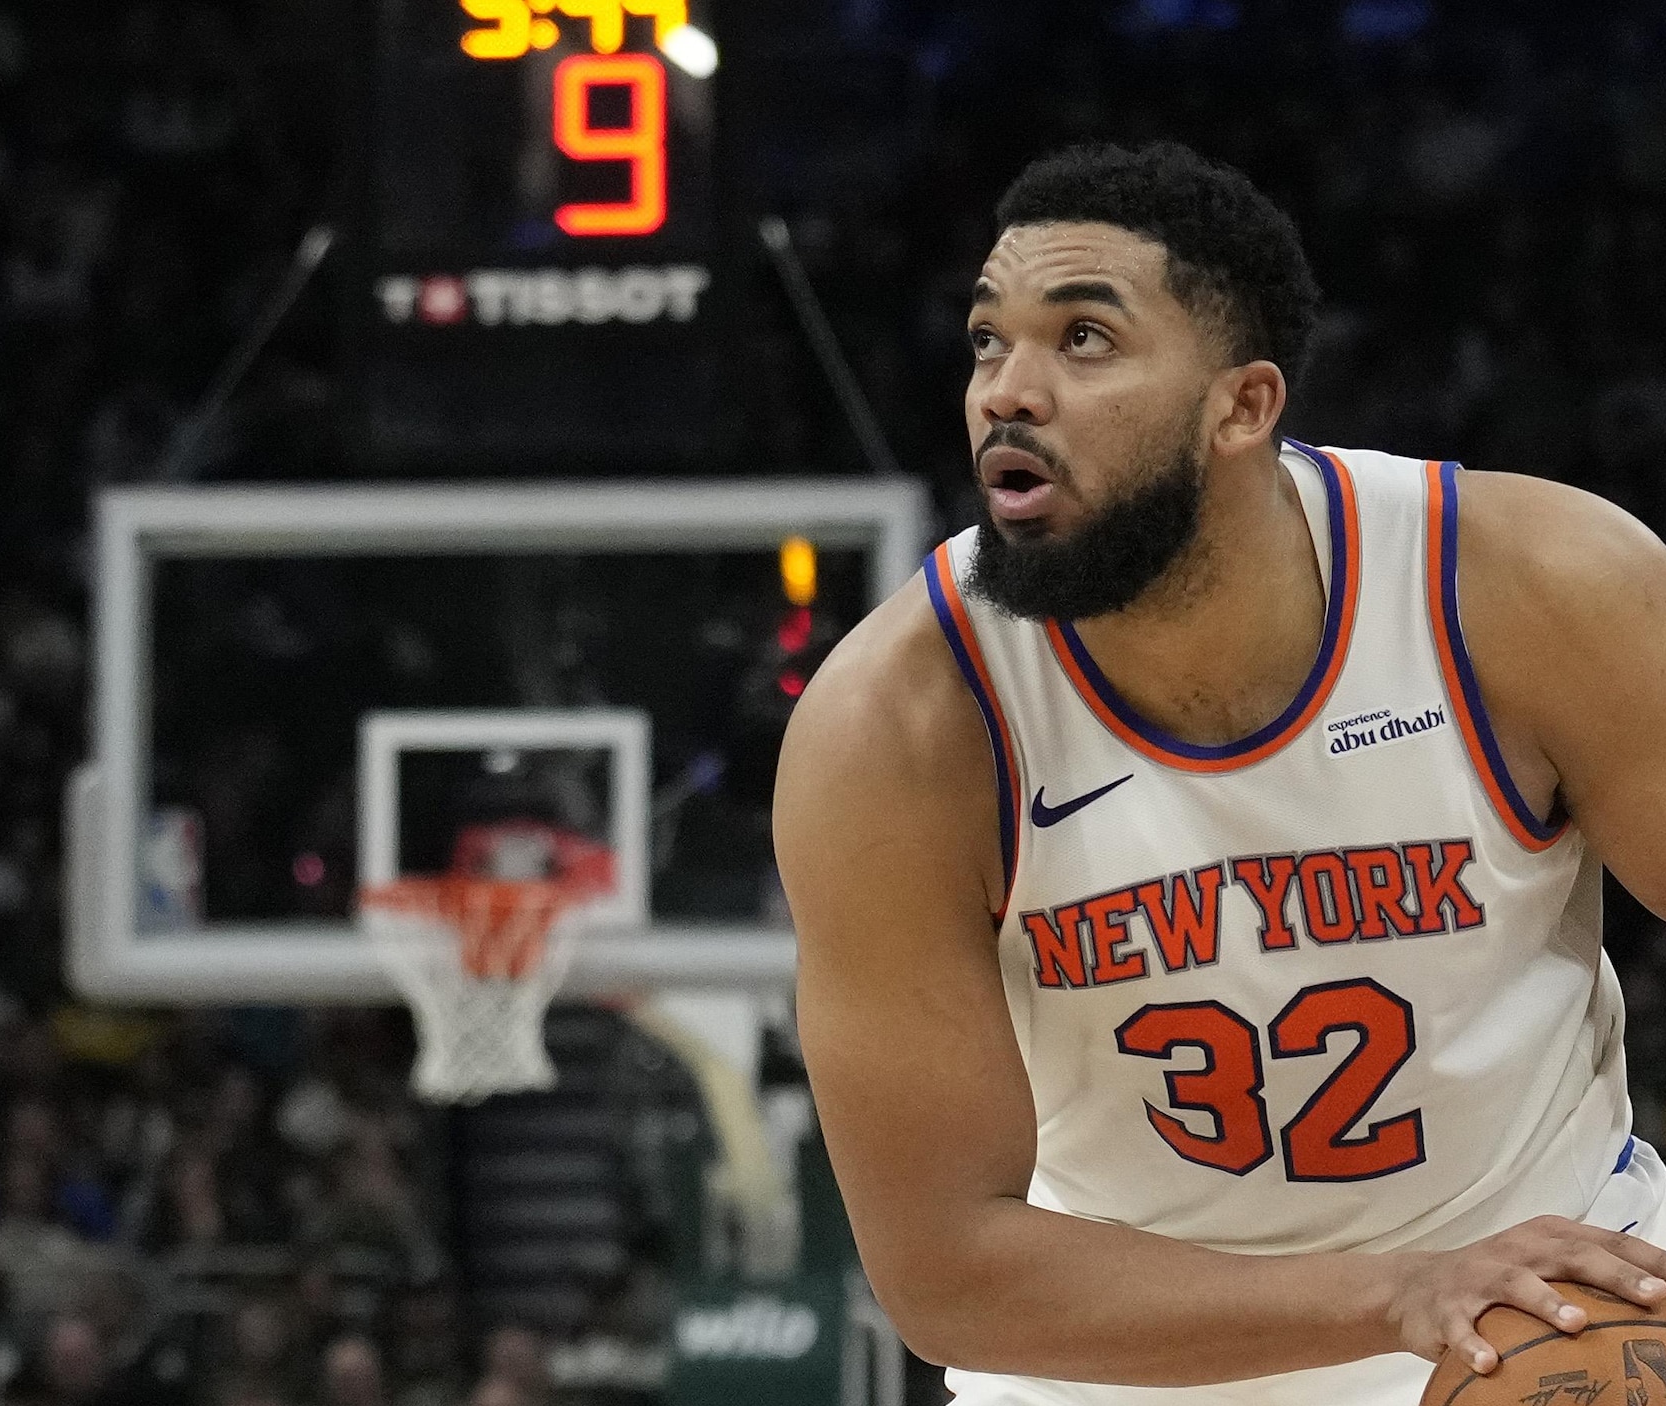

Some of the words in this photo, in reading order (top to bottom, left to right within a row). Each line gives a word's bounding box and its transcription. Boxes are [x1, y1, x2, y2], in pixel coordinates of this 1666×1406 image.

[553, 53, 668, 237] 9
[469, 266, 710, 325] TISSOT
[1328, 708, 1392, 732] experience
[1330, 728, 1377, 754] abu
[1019, 861, 1225, 990] NEW
[1228, 838, 1487, 953] YORK
[1114, 976, 1427, 1182] 32
